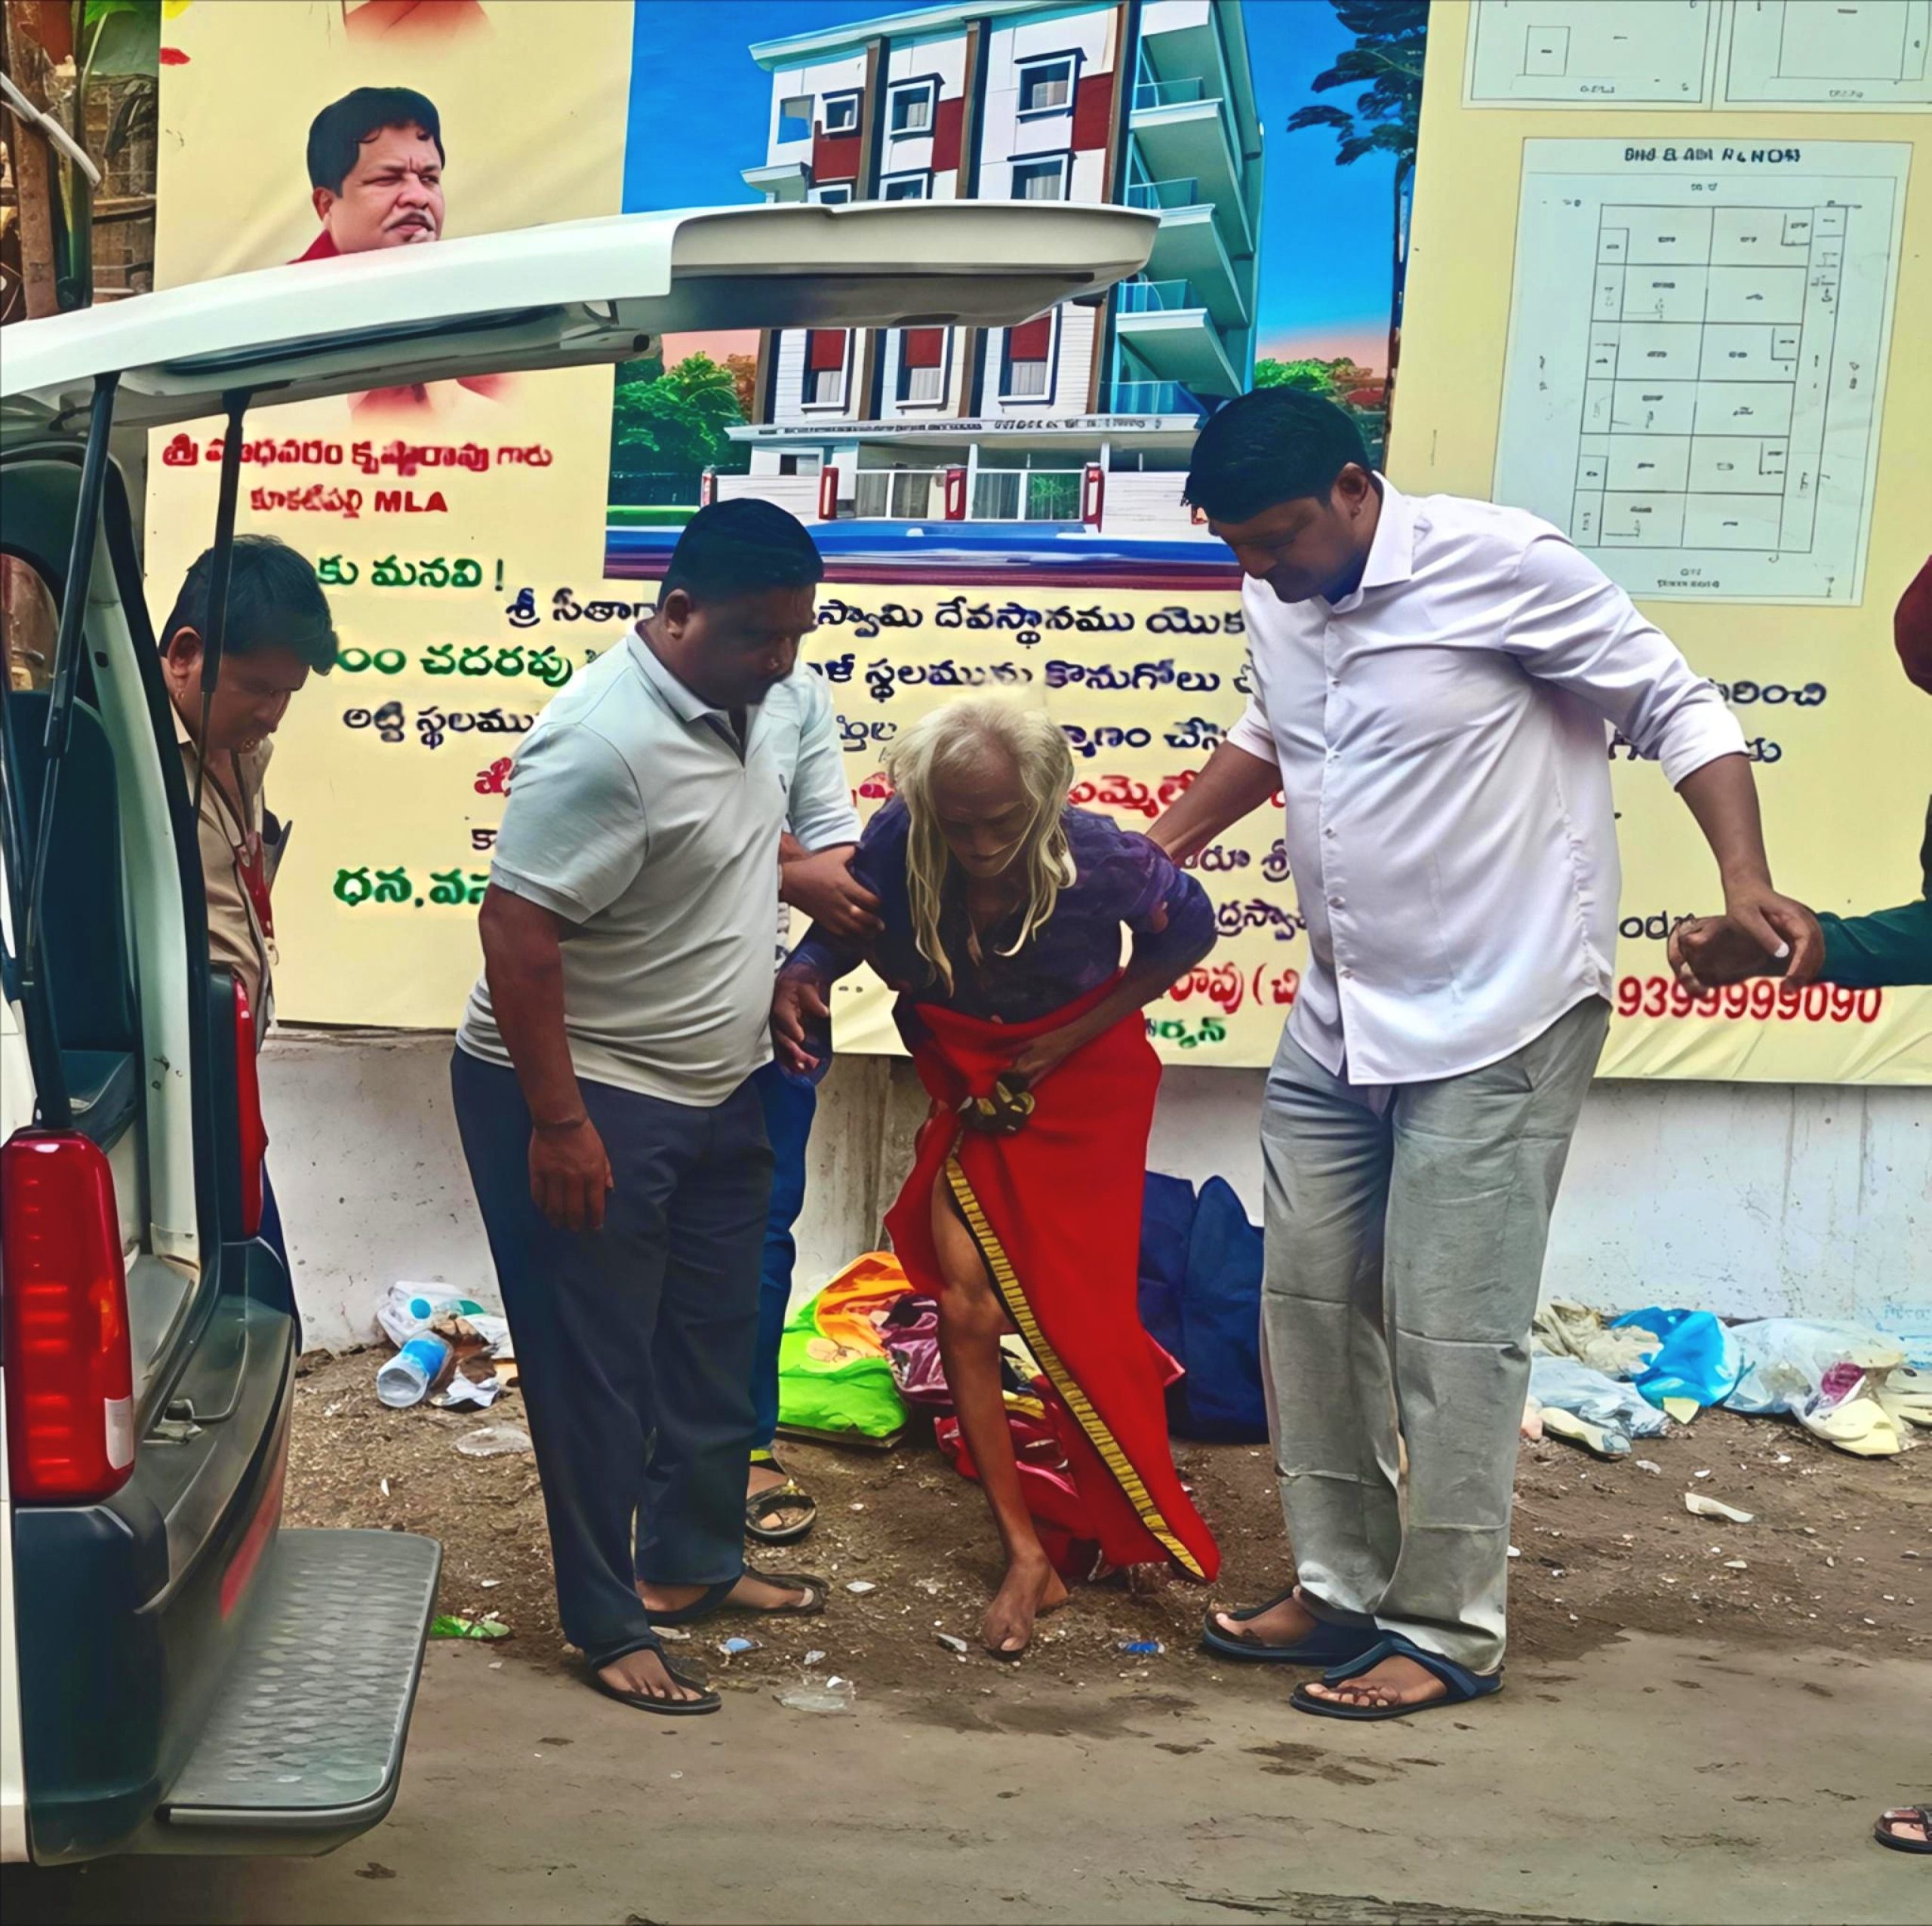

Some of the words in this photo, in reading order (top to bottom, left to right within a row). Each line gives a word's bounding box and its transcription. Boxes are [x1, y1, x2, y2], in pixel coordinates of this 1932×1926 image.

[497, 444, 552, 466] గారు
[374, 491, 448, 512] MLA
[371, 555, 482, 588] మనవి
[506, 587, 540, 628] శ్రీ
[935, 595, 1134, 645] దేవస్థానము
[420, 643, 574, 688] చదరపు
[1045, 660, 1220, 693] కొనుగోలు
[1618, 976, 1882, 1023] 9399999090
